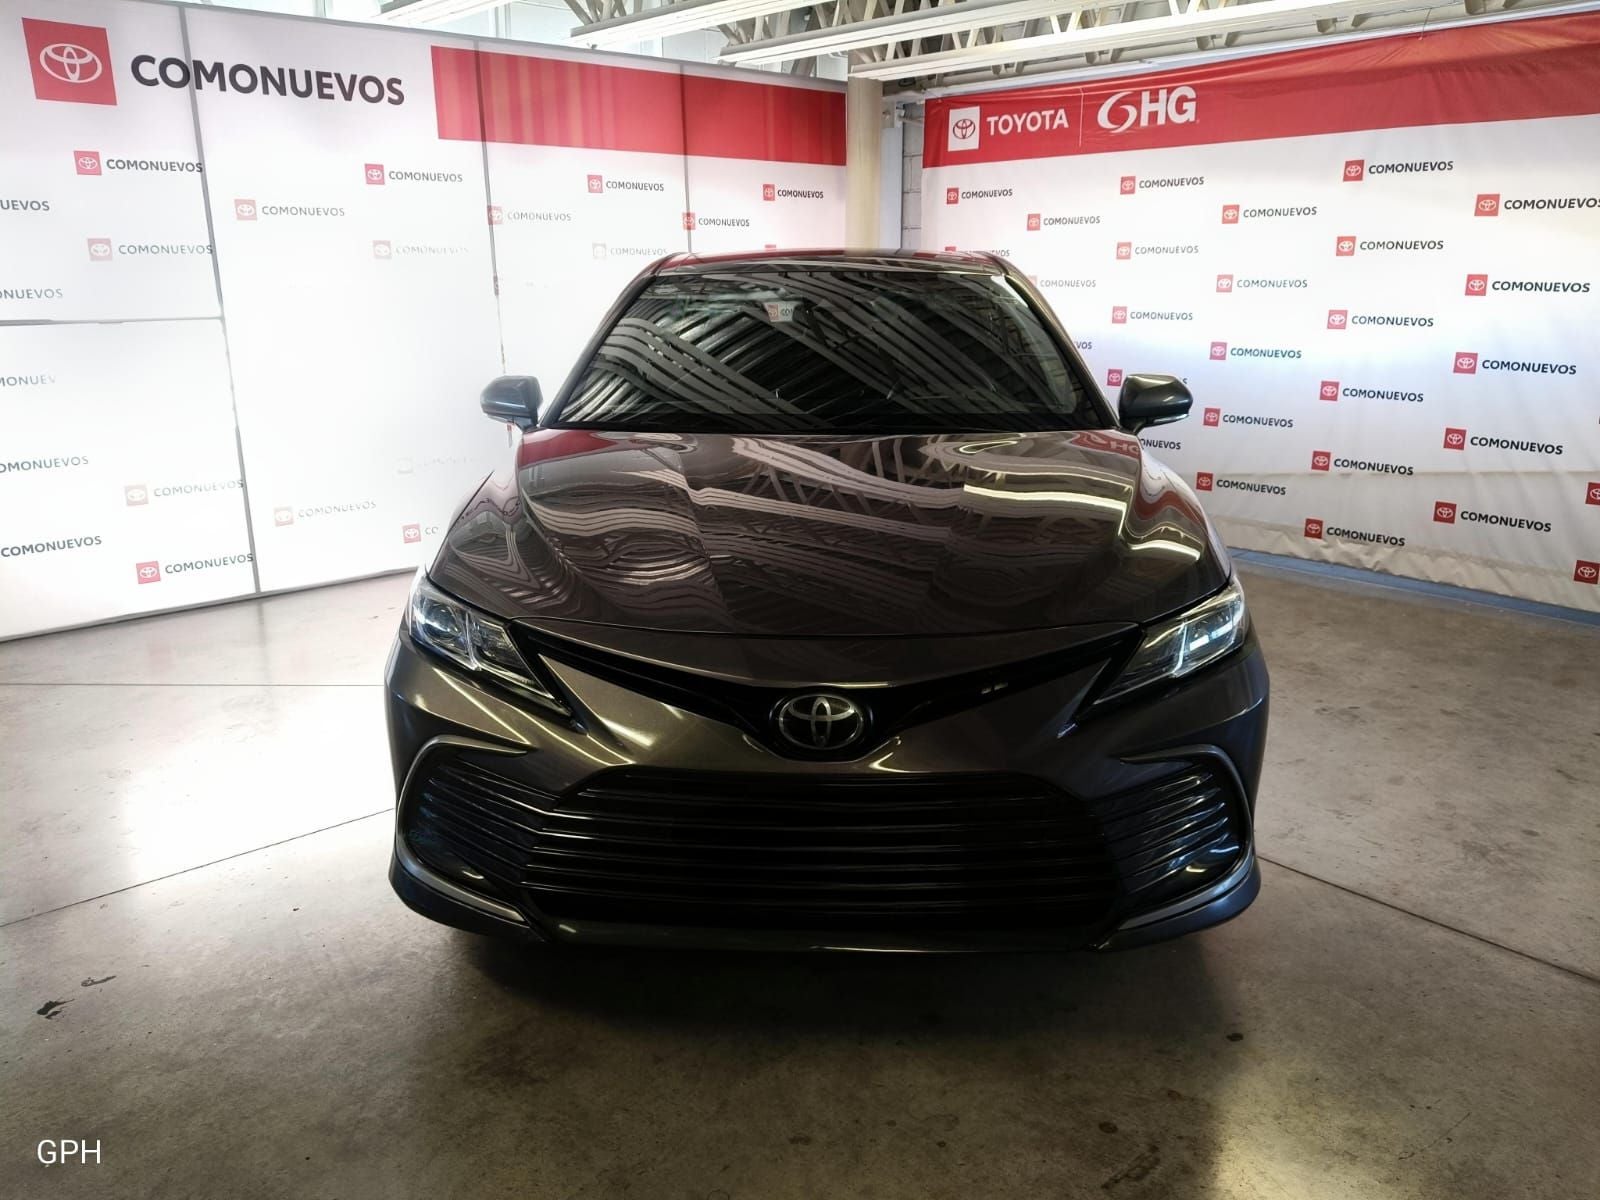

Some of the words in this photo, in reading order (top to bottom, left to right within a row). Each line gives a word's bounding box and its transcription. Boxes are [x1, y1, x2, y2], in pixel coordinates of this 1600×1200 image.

[131, 55, 405, 106] COMONUEVOS
[986, 108, 1070, 136] TOYOTA
[106, 158, 204, 174] COMONUEVOS
[1368, 160, 1454, 175] COMONUEVOS
[388, 170, 463, 183] COMONUEVOS
[1138, 175, 1205, 189] COMONUEVOS
[605, 180, 665, 192] COMONUEVOS
[776, 188, 824, 199] COMONUEVOS
[961, 187, 1013, 200] COMONUEVOS
[261, 205, 345, 217] COMONUEVOS
[507, 211, 572, 222] COMONUEVOS
[1242, 206, 1318, 219] COMONUEVOS
[697, 217, 750, 228] COMONUEVOS
[1042, 215, 1101, 226] COMONUEVOS
[118, 243, 214, 255] COMONUEVOS
[1134, 244, 1200, 256] COMONUEVOS
[1359, 239, 1444, 251] COMONUEVOS
[1039, 279, 1097, 288] COMONUEVOS
[1236, 279, 1308, 289] COMONUEVOS
[1491, 280, 1591, 293] COMONUEVOS
[1129, 311, 1194, 321] COMONUEVOS
[1351, 315, 1434, 328] COMONUEVOS
[1229, 347, 1302, 359] COMONUEVOS
[1481, 359, 1577, 376] COMONUEVOS
[1342, 387, 1424, 403] COMONUEVOS
[1222, 414, 1294, 428] COMONUEVOS
[1469, 436, 1564, 456] COMONUEVOS
[1333, 458, 1415, 477] COMONUEVOS
[153, 479, 244, 498] COMONUEVOS
[1215, 478, 1287, 496] COMONUEVOS
[1460, 510, 1552, 533] COMONUEVOS
[1326, 526, 1406, 547] COMONUEVOS
[0, 535, 103, 558] COMONUEVOS
[165, 553, 254, 575] COMONUEVOS
